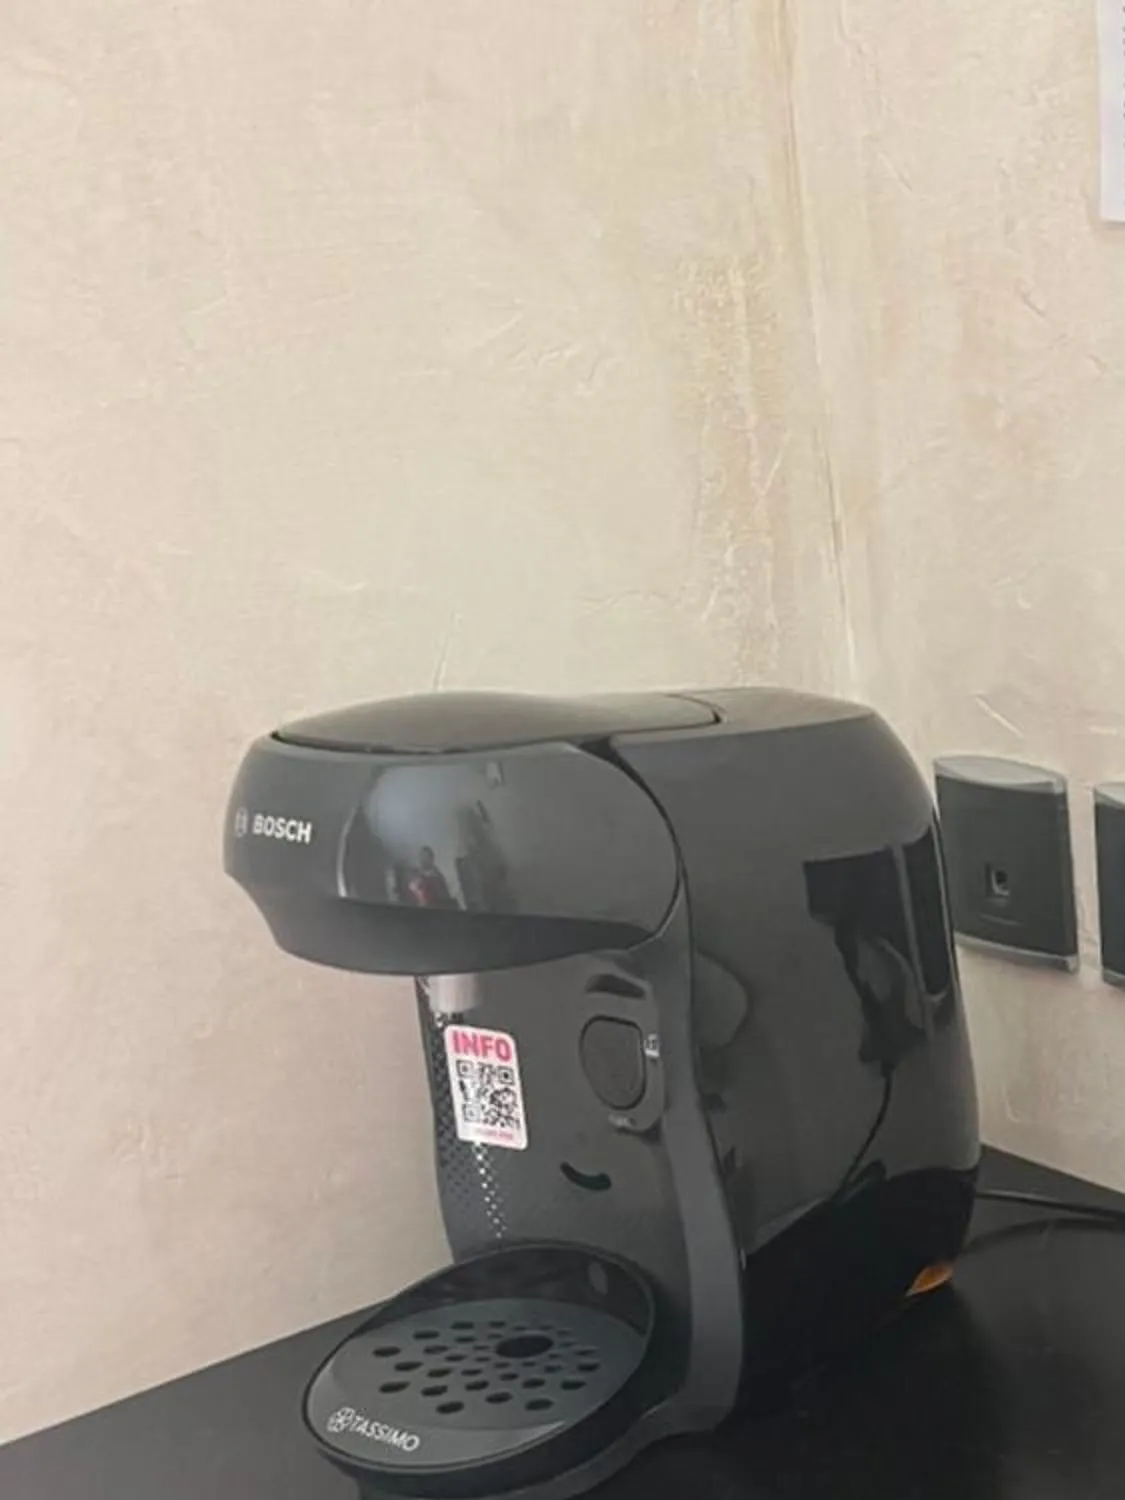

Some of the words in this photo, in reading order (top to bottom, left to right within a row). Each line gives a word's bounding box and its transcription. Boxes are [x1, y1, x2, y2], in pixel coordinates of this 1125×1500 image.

[252, 813, 313, 844] BOSCH
[452, 1030, 512, 1062] INFO
[349, 1414, 420, 1452] TASSIMO
